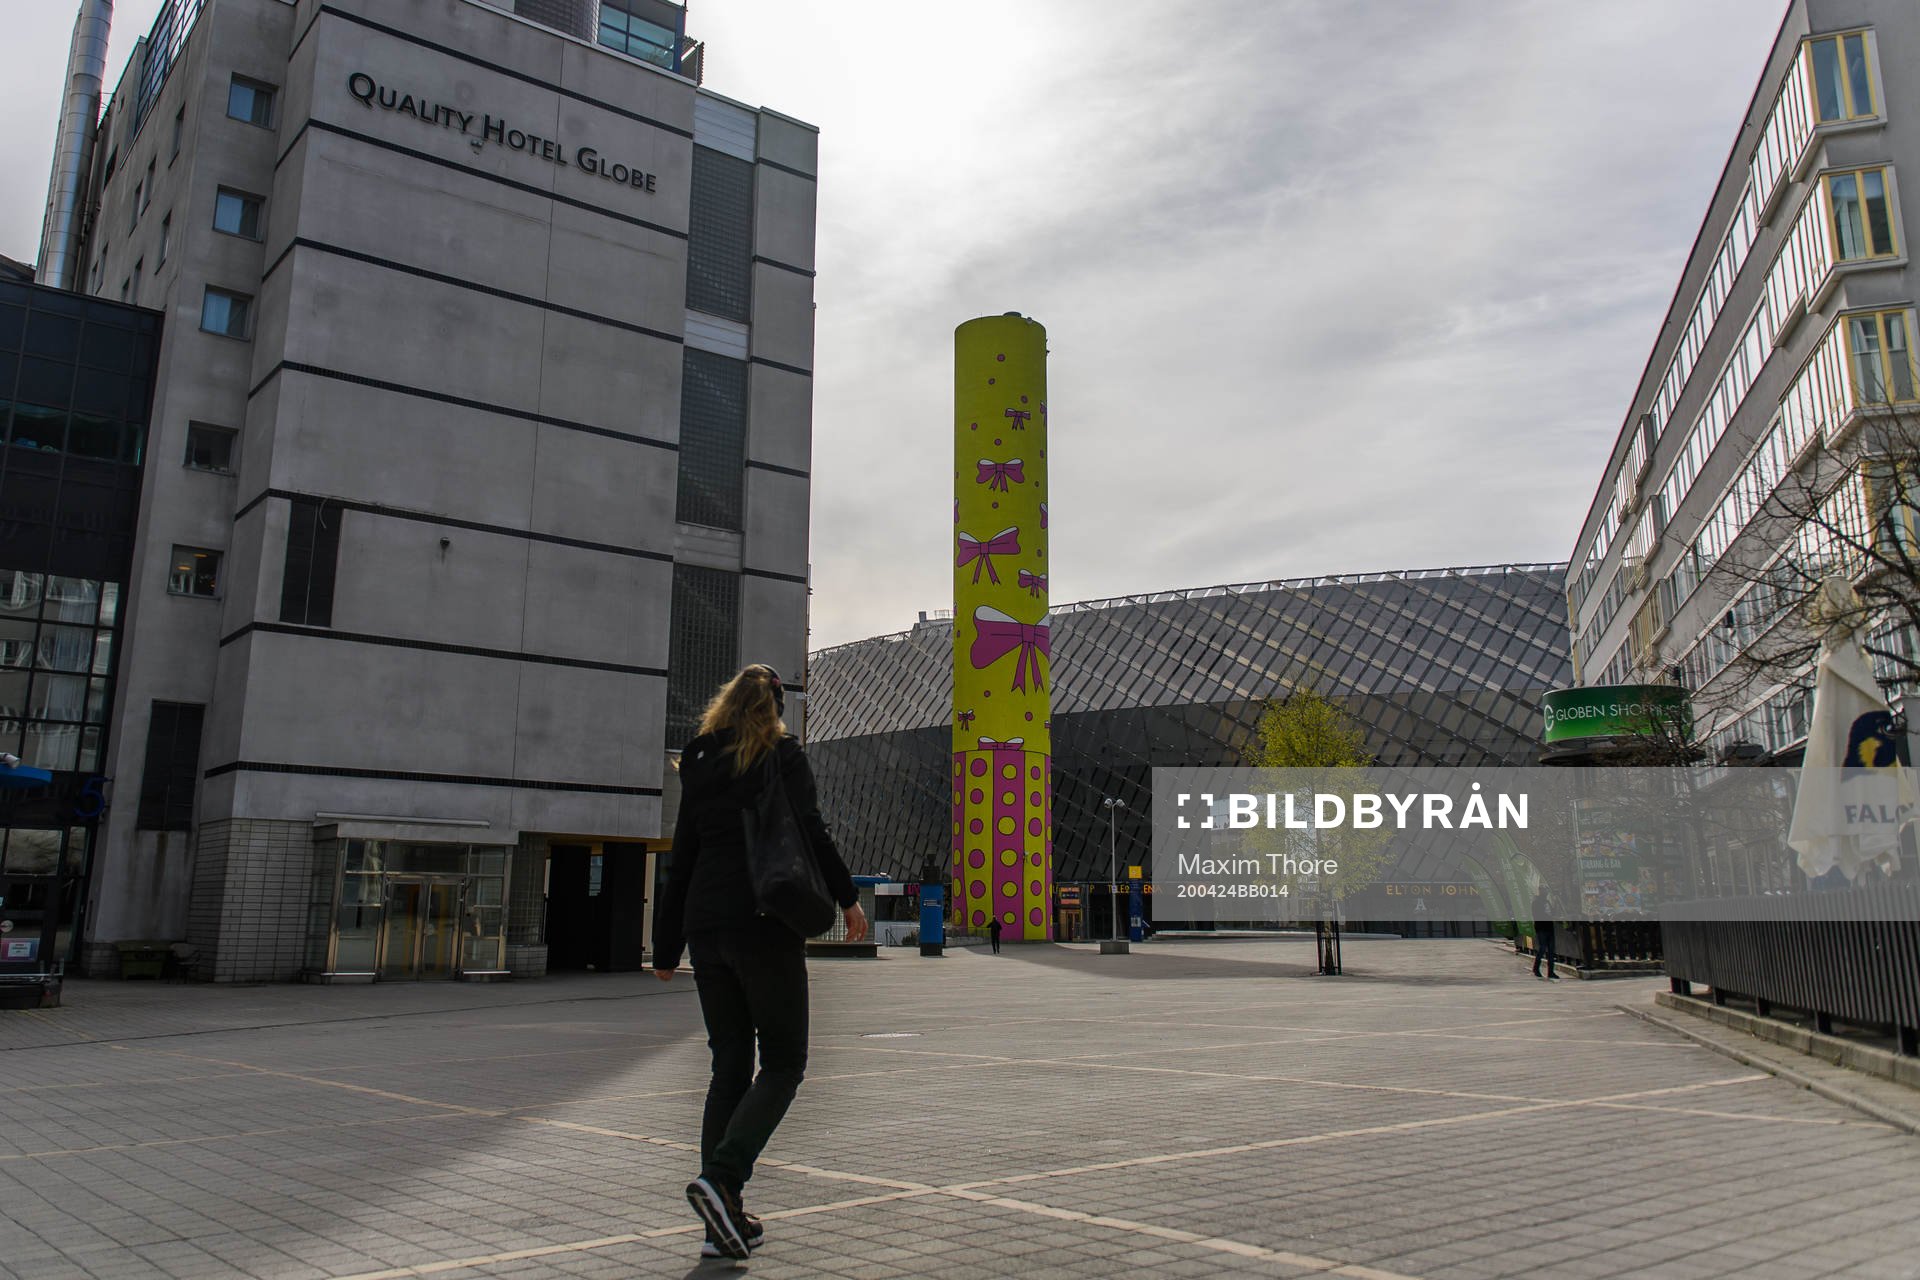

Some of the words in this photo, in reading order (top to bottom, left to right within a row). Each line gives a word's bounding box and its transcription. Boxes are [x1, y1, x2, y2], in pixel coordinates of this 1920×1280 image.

[348, 72, 474, 134] QUALITY
[482, 114, 568, 166] HOTEL
[576, 147, 657, 194] GLOBE
[1556, 704, 1606, 721] GLOBEN
[1385, 884, 1432, 896] ELTON
[1440, 884, 1480, 896] JOHN
